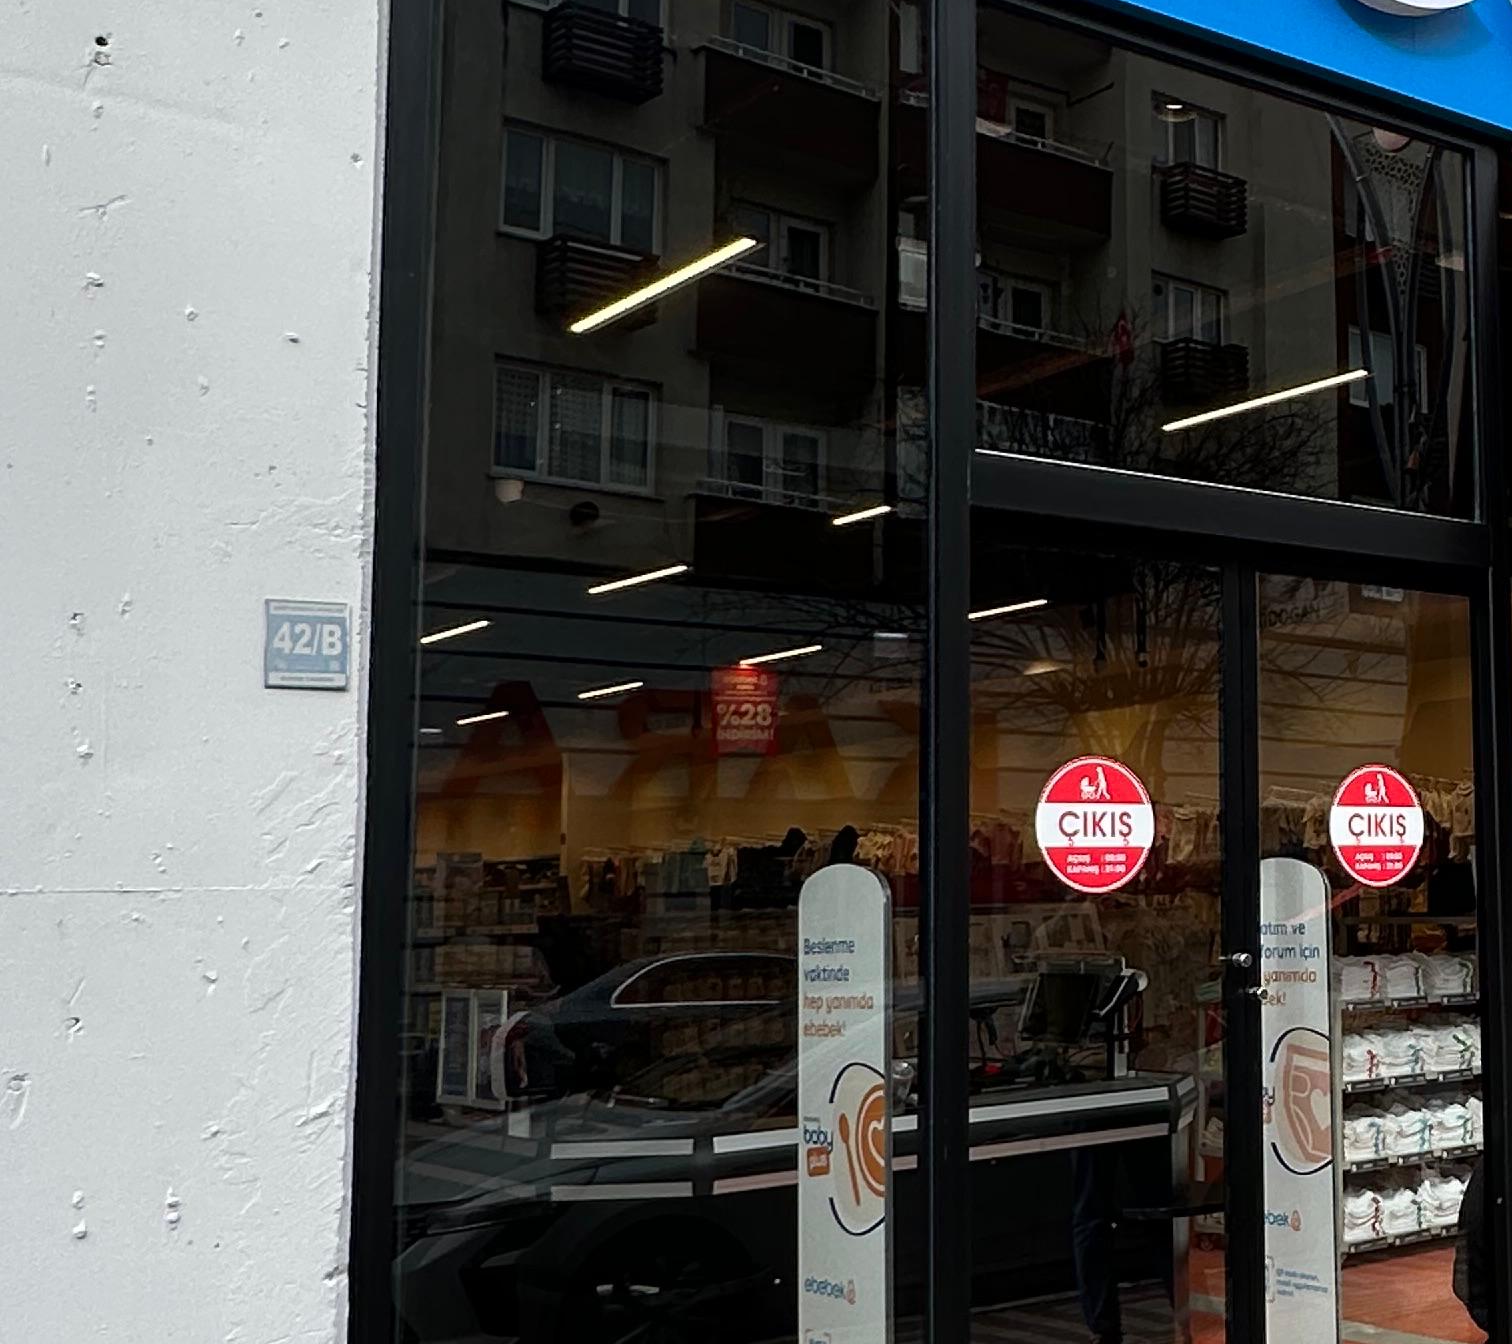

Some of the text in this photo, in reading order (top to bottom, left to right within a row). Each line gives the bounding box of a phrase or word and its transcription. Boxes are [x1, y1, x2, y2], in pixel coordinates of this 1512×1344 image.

[272, 621, 343, 656] 42/B
[716, 702, 772, 726] %28
[1058, 810, 1133, 846] ÇIKIŞ
[1348, 812, 1407, 844] ÇIKIŞ
[1292, 922, 1306, 936] ve
[803, 992, 874, 1014] hep yanımda
[803, 1123, 833, 1152] baby
[804, 1276, 846, 1300] ebebek
